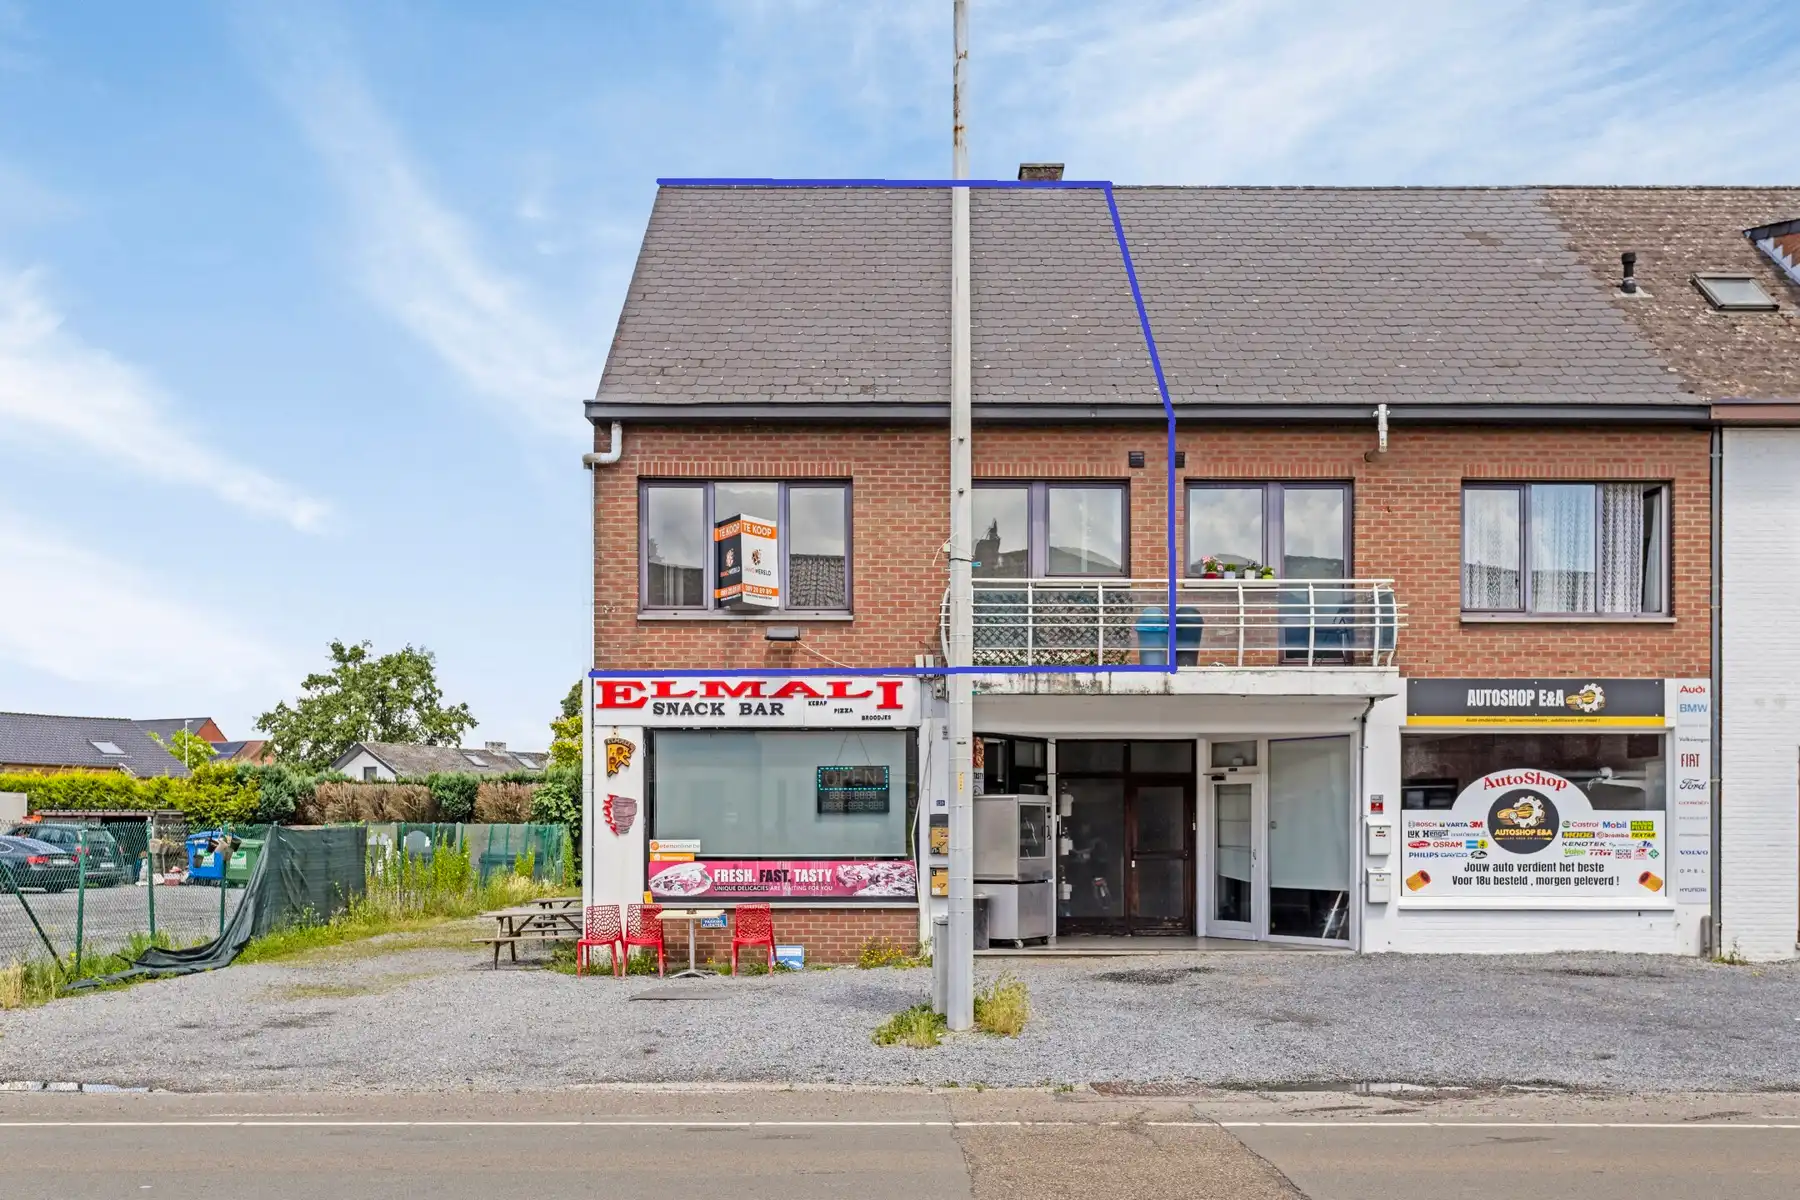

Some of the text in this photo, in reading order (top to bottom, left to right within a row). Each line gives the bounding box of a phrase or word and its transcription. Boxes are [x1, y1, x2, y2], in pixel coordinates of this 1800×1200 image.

[718, 522, 740, 538] TE KOOP
[743, 523, 772, 536] TE KOOP
[596, 681, 903, 709] ELMALI
[1467, 689, 1564, 706] AUTOSHOP E&A
[653, 702, 784, 716] SNACK BAR
[1680, 704, 1708, 712] BMW
[1681, 754, 1700, 767] FIAT
[824, 769, 876, 786] OPEN
[1484, 772, 1567, 791] AutoShop
[1680, 778, 1706, 790] Ford
[1422, 830, 1449, 838] Hengst
[1464, 862, 1605, 872] Jouw auto verdient het beste
[714, 869, 832, 882] FRESH. FAST. TASTY
[1452, 876, 1473, 885] Voor
[1476, 876, 1491, 885] 18u
[1494, 876, 1528, 885] besteld
[1536, 878, 1571, 886] morgen
[1574, 876, 1614, 886] geleverd
